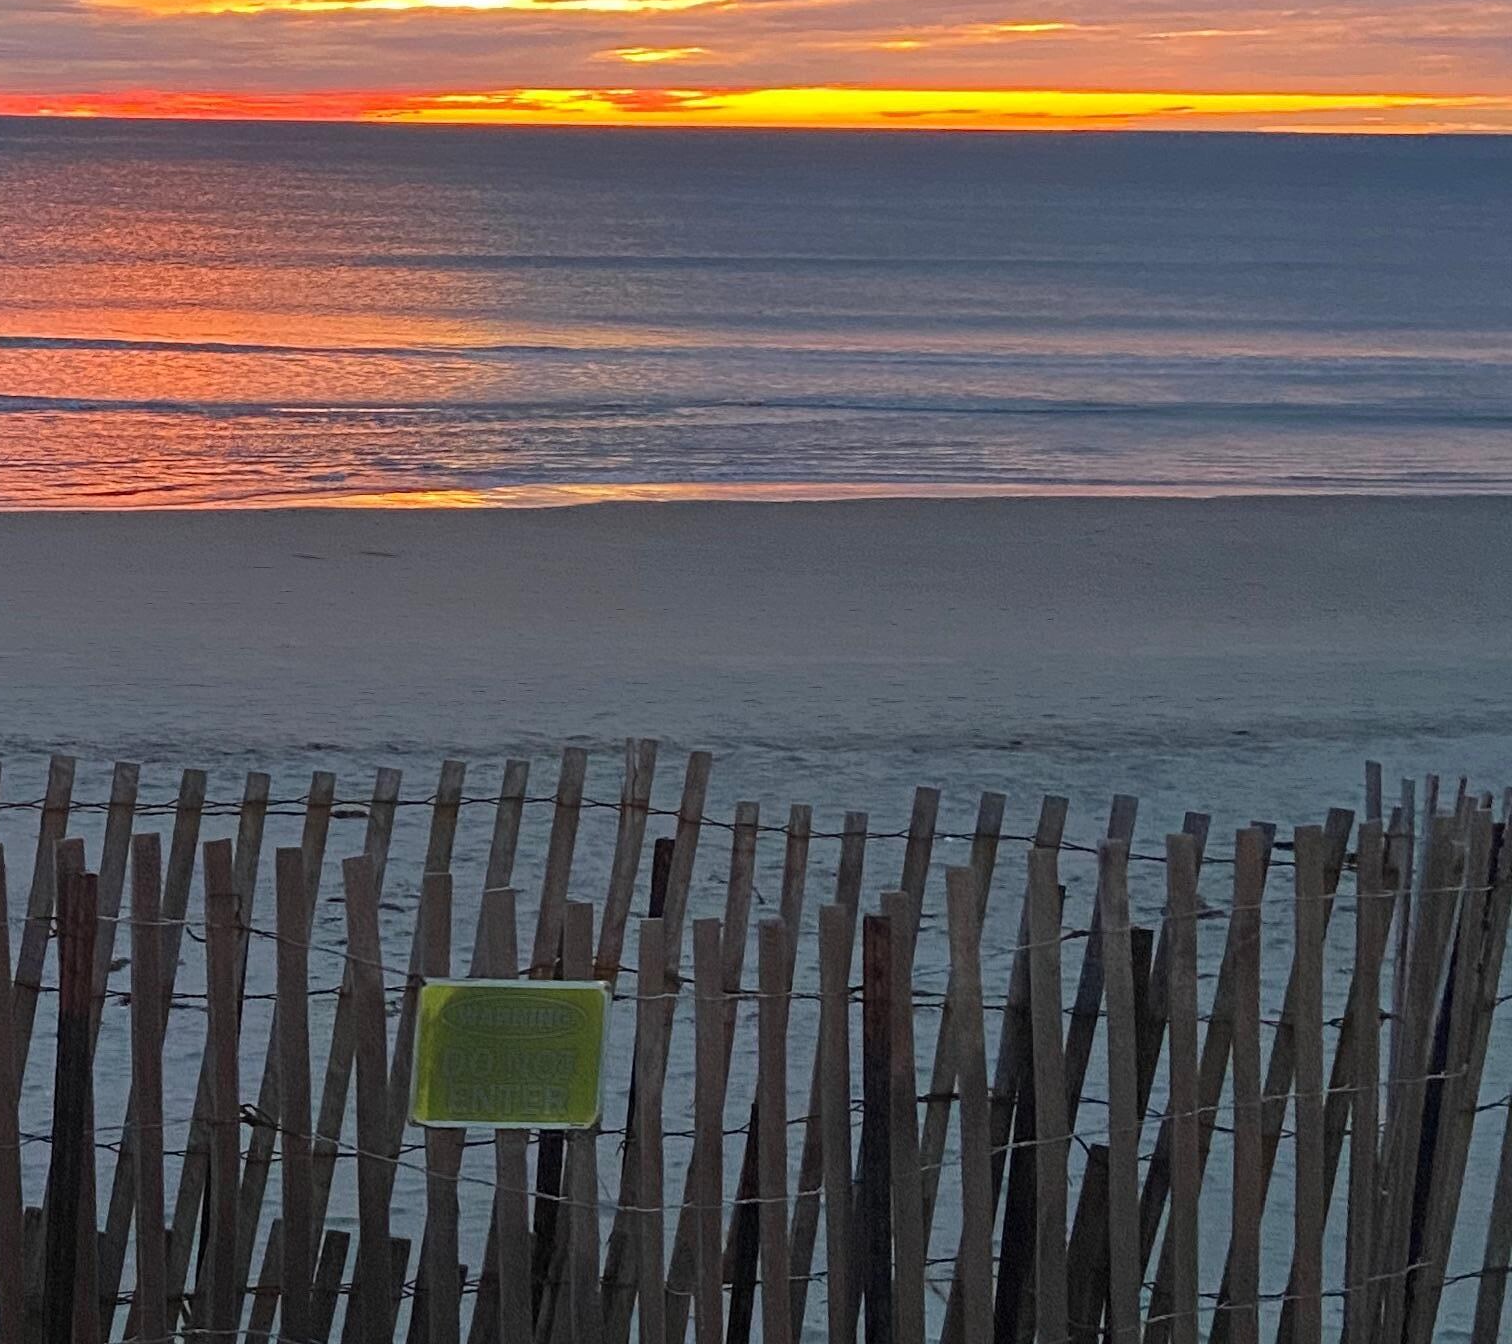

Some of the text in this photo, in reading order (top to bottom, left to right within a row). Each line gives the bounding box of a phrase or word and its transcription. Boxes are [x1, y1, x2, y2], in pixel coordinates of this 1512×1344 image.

[458, 1006, 574, 1027] WARNING
[443, 1048, 577, 1078] DO NOT
[448, 1085, 569, 1116] ENTER
